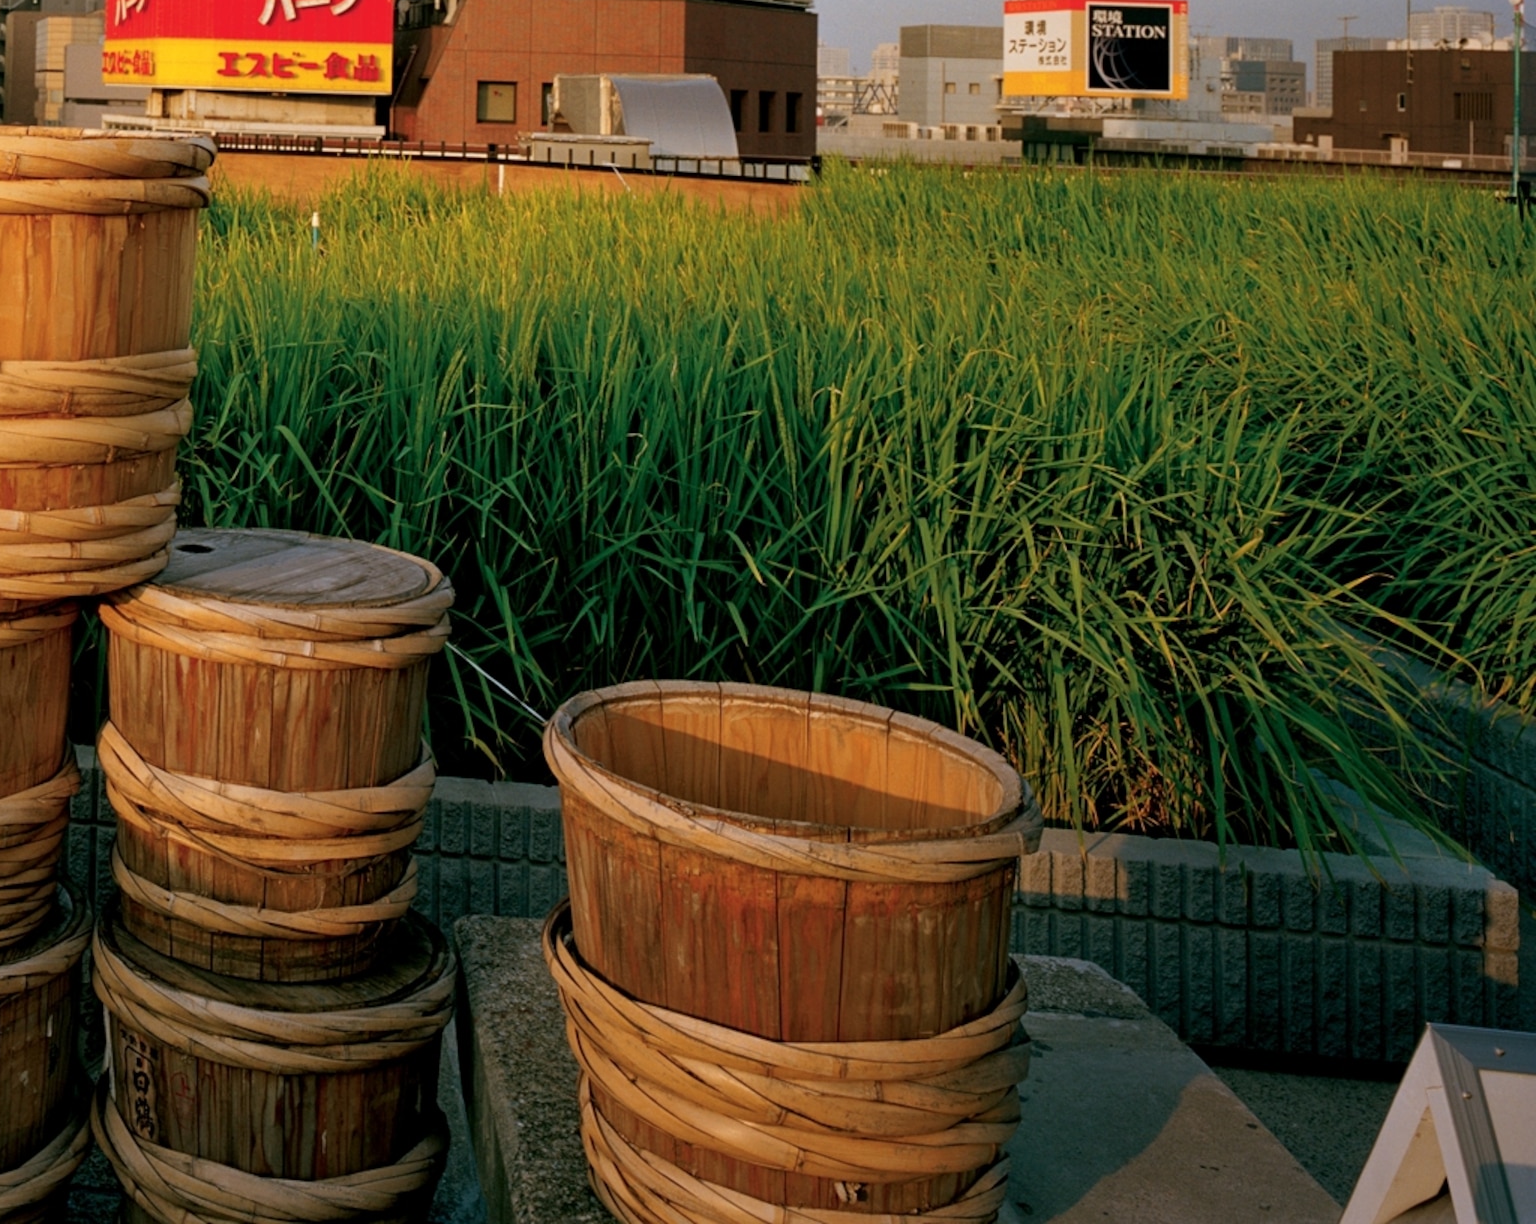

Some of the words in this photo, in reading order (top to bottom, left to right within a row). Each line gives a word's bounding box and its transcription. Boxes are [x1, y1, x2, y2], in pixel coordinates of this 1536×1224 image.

[1092, 9, 1123, 24] 環境
[1091, 25, 1166, 39] STATION
[1008, 38, 1067, 54] ステーション
[217, 51, 383, 82] エスビー食品
